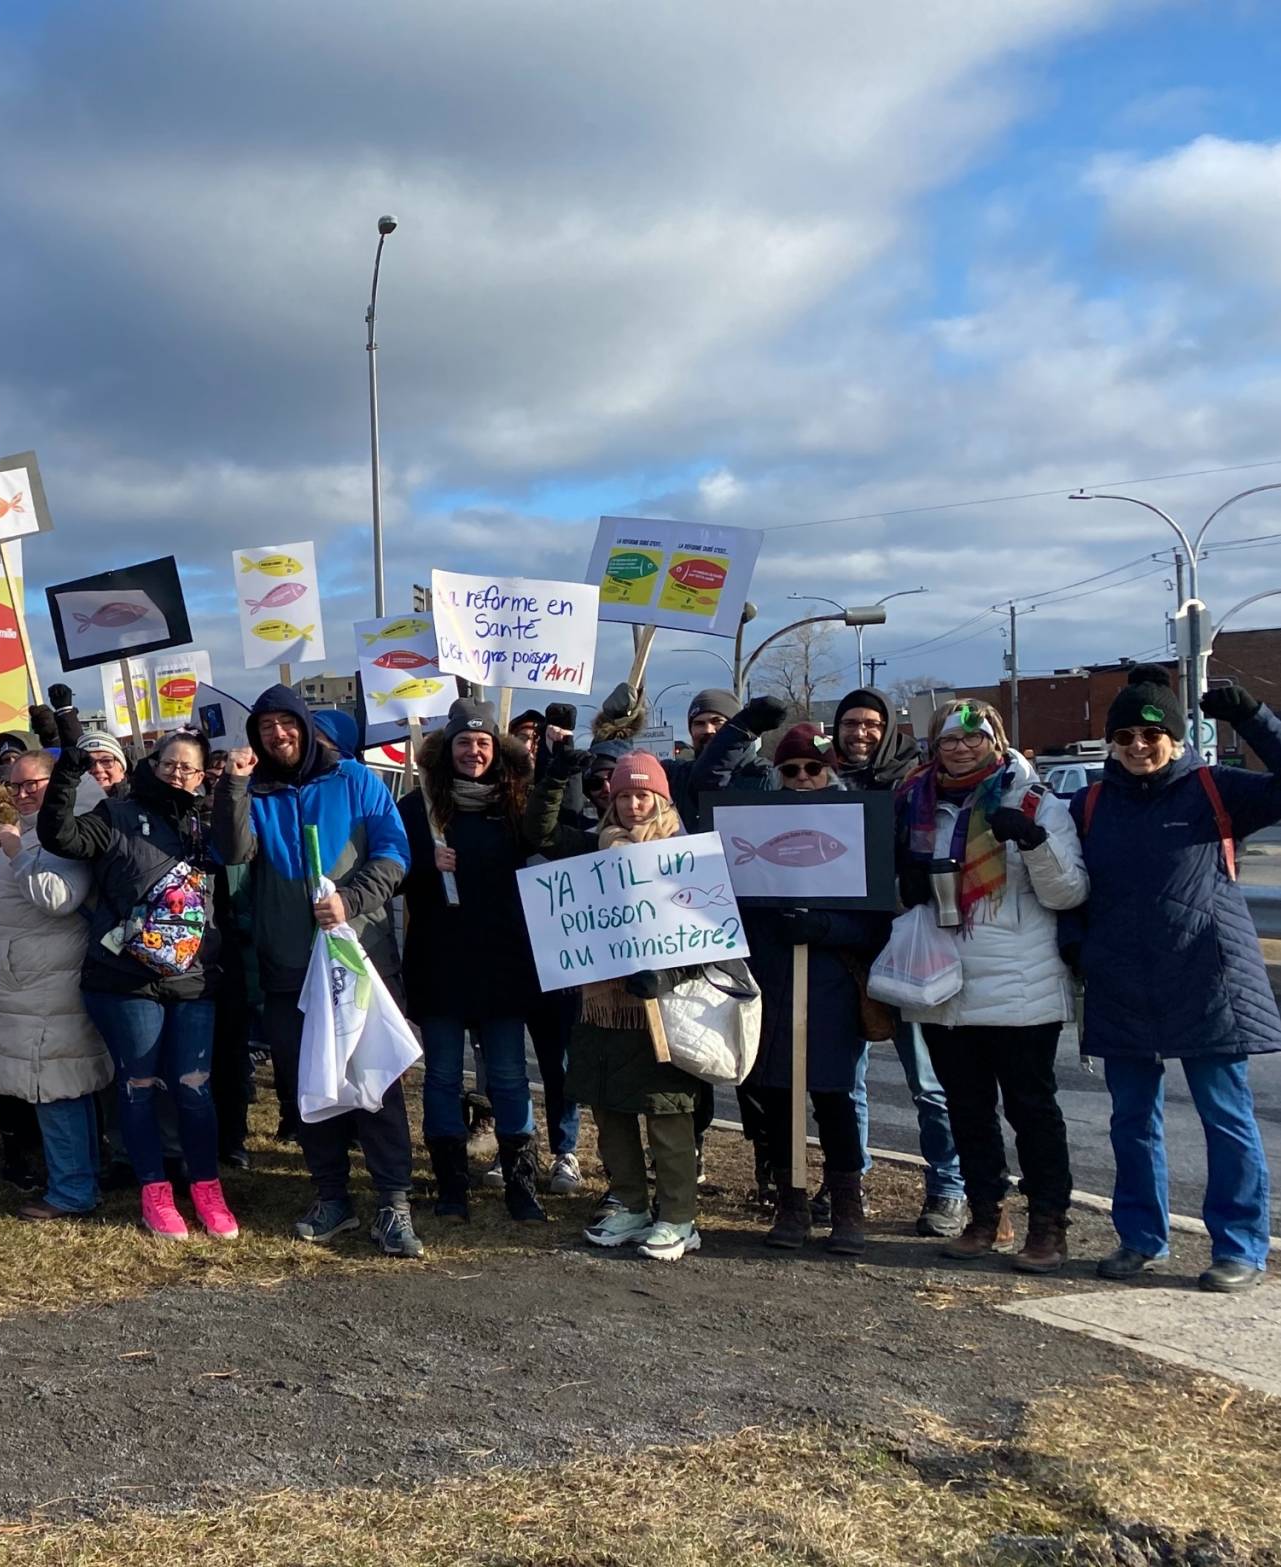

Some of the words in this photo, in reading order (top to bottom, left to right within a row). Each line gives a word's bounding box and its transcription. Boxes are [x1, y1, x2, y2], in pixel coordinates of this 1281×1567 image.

[466, 585, 538, 612] réforme
[547, 598, 573, 616] en
[475, 613, 542, 640] Santé
[657, 850, 696, 877] un
[560, 945, 595, 971] au
[609, 917, 740, 961] ministère?
